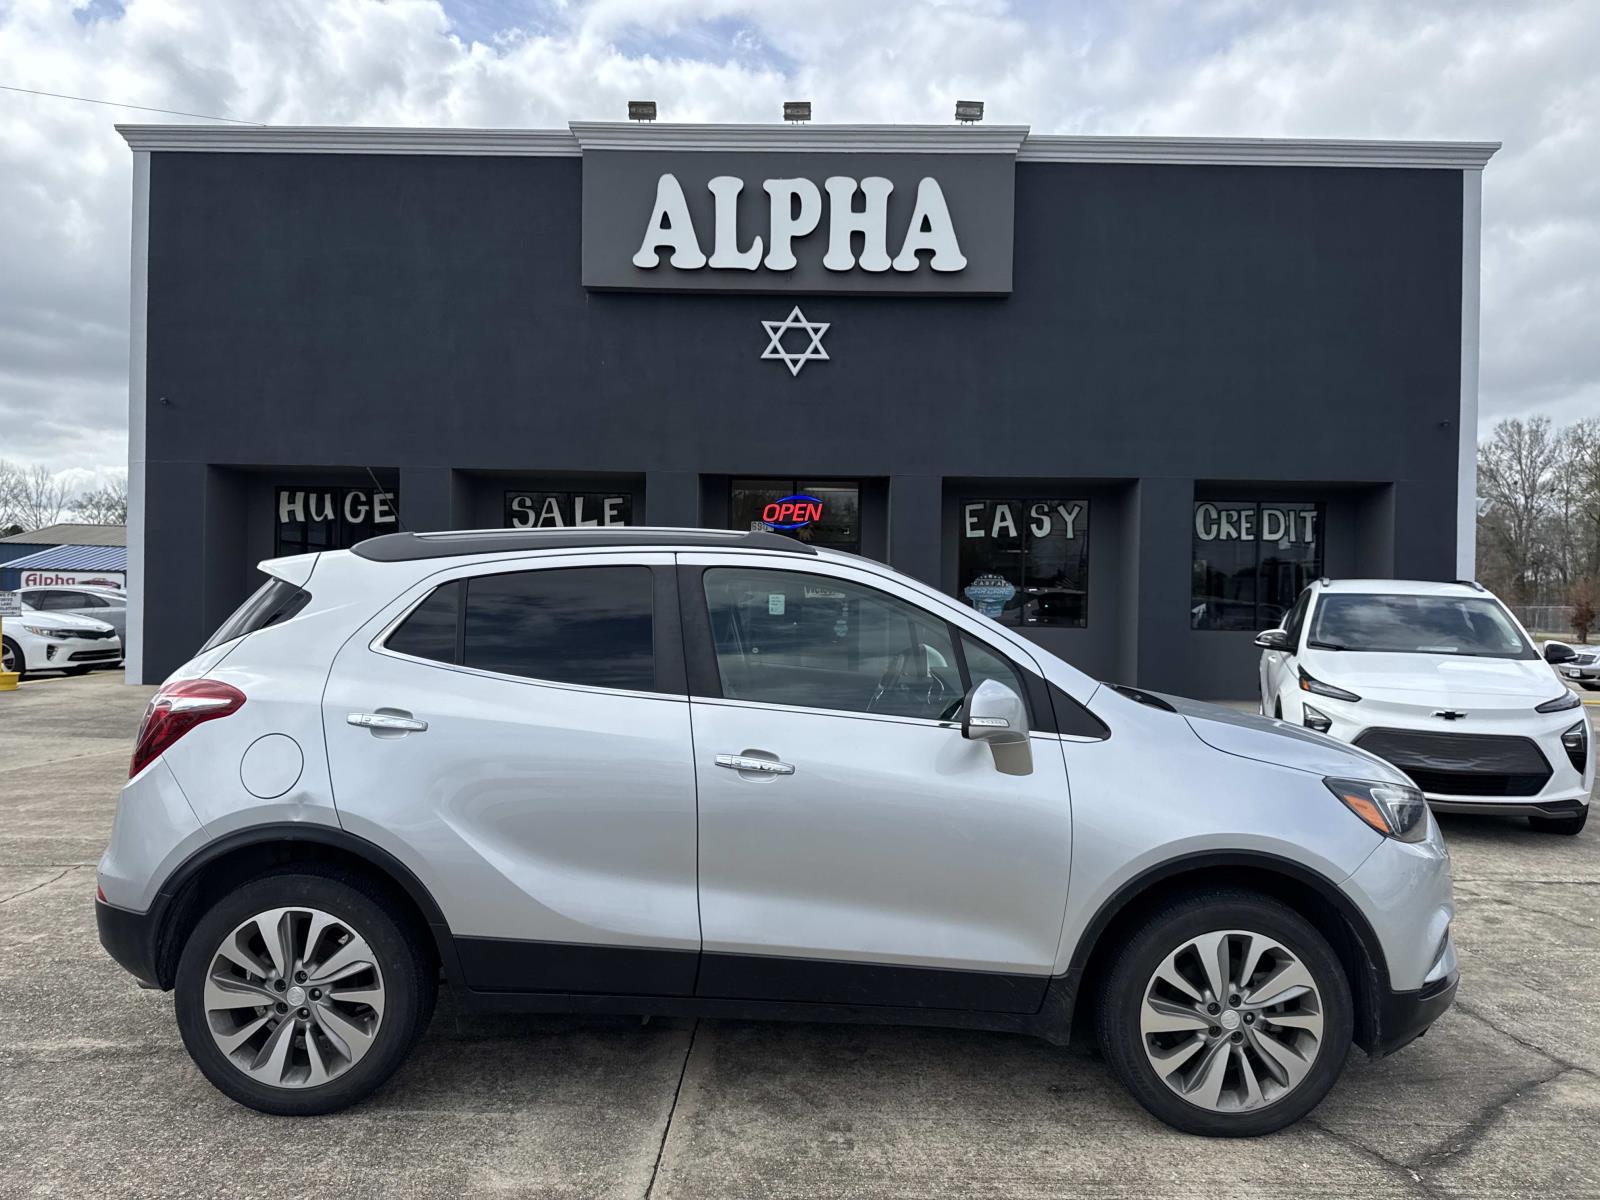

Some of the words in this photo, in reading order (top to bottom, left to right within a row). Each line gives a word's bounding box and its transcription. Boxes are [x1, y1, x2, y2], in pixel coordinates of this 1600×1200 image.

[632, 173, 968, 272] ALPHA
[279, 491, 396, 523] HUGE
[511, 497, 625, 528] SALE
[762, 503, 823, 522] OPEN
[964, 503, 1081, 539] EASY
[1195, 503, 1318, 543] CREDIT
[25, 573, 76, 586] Alpha
